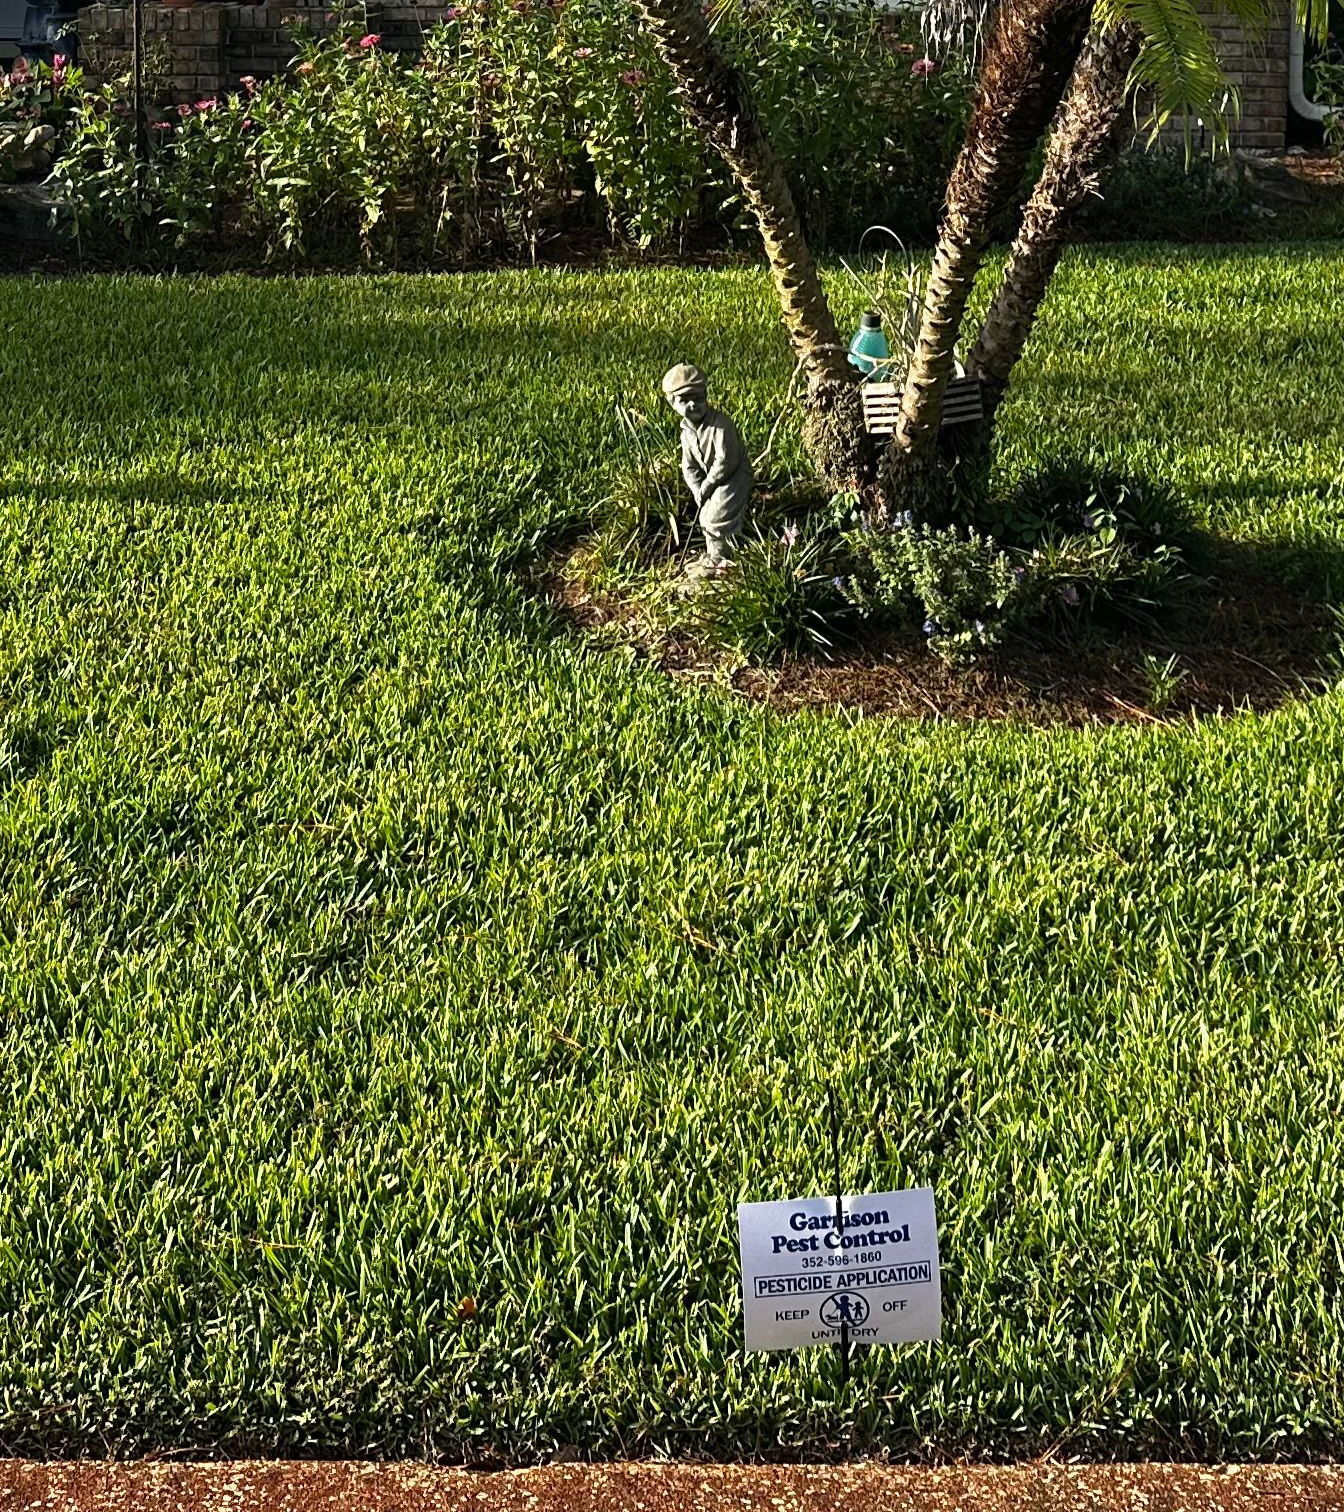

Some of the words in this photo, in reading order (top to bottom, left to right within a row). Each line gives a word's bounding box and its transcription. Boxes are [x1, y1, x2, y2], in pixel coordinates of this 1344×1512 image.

[771, 1232, 820, 1254] Pest
[823, 1224, 911, 1249] Control
[801, 1250, 882, 1269] 352-596-1860
[758, 1274, 832, 1295] PESTICIDE
[836, 1264, 929, 1288] APPLICATION
[775, 1309, 810, 1321] KEEP
[882, 1300, 908, 1312] OFF
[811, 1328, 848, 1340] UNTI
[851, 1326, 880, 1338] DRY
